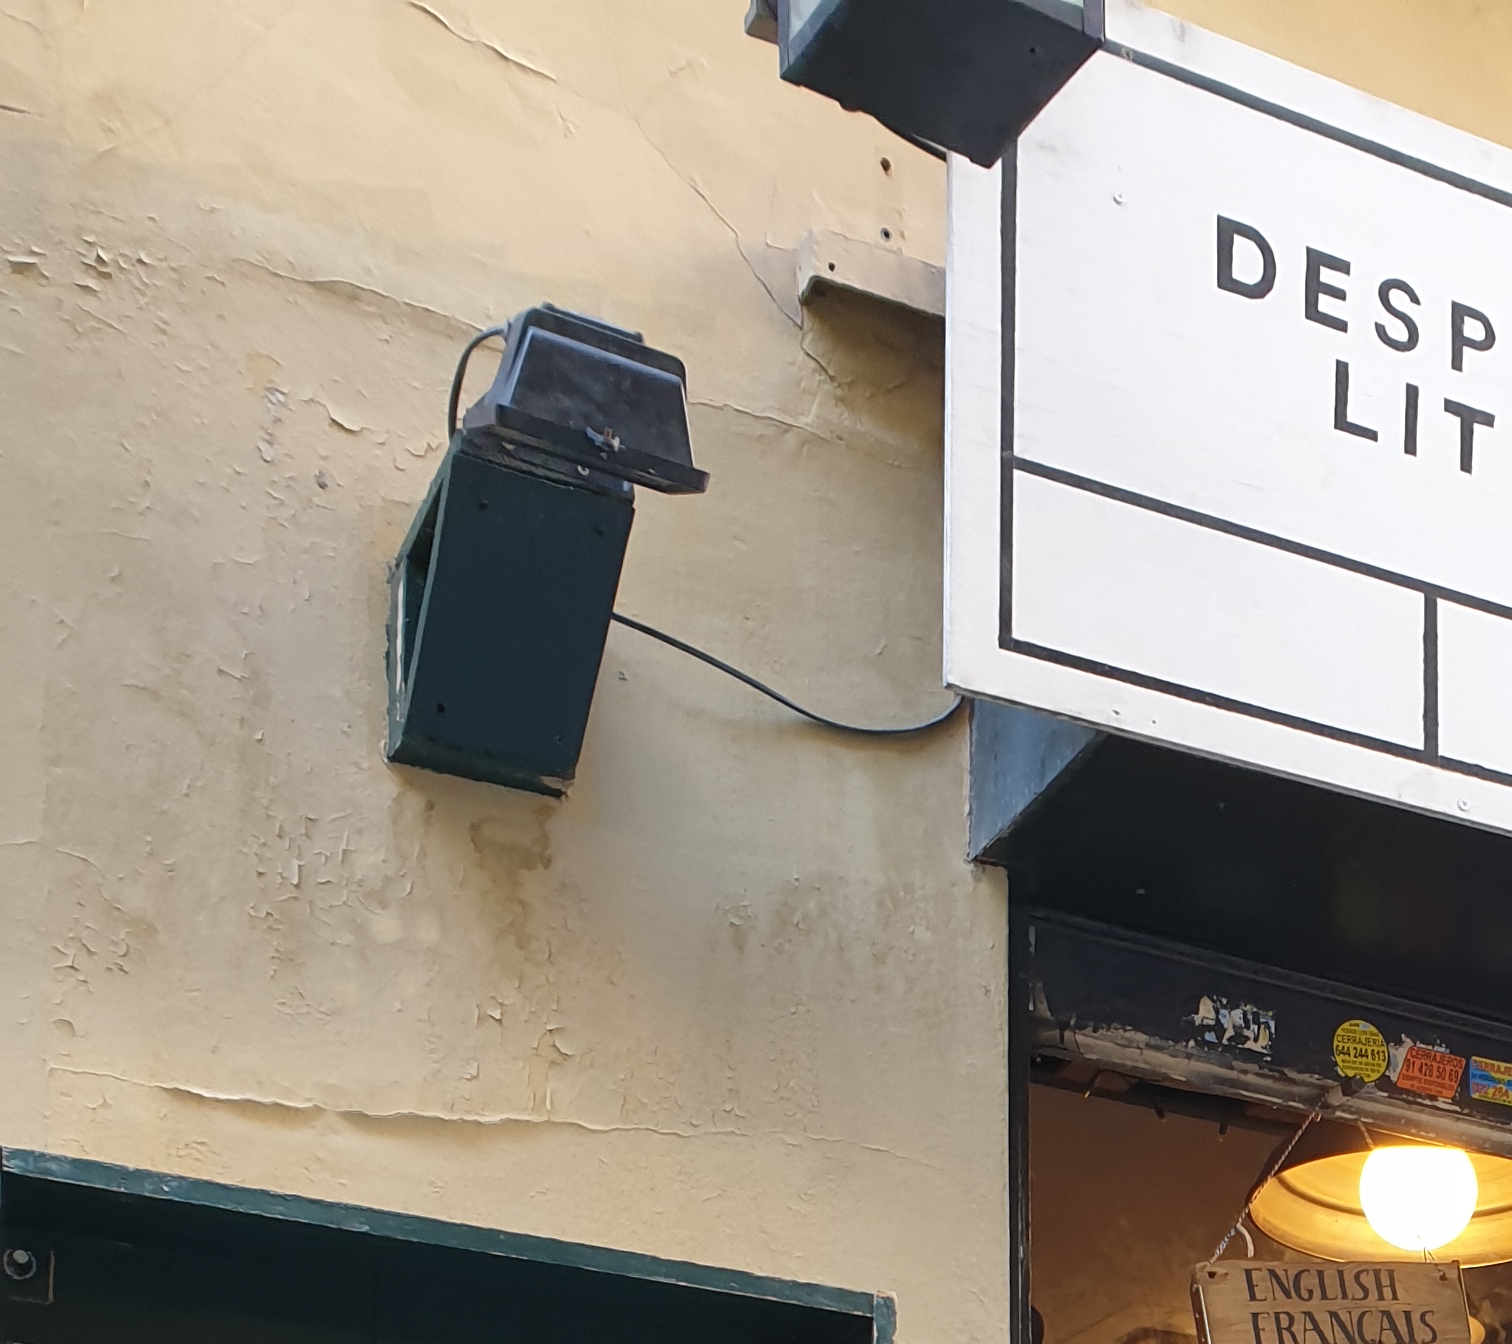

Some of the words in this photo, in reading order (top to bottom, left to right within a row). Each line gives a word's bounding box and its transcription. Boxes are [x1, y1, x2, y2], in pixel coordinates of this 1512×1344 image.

[1371, 1047, 1386, 1062] 613
[1410, 1047, 1463, 1070] CERRAJEROS
[1405, 1058, 1415, 1073] 91
[1418, 1060, 1433, 1078] 428
[1435, 1065, 1446, 1080] 50
[1448, 1068, 1460, 1083] 69
[1243, 1267, 1400, 1302] ENGLISH
